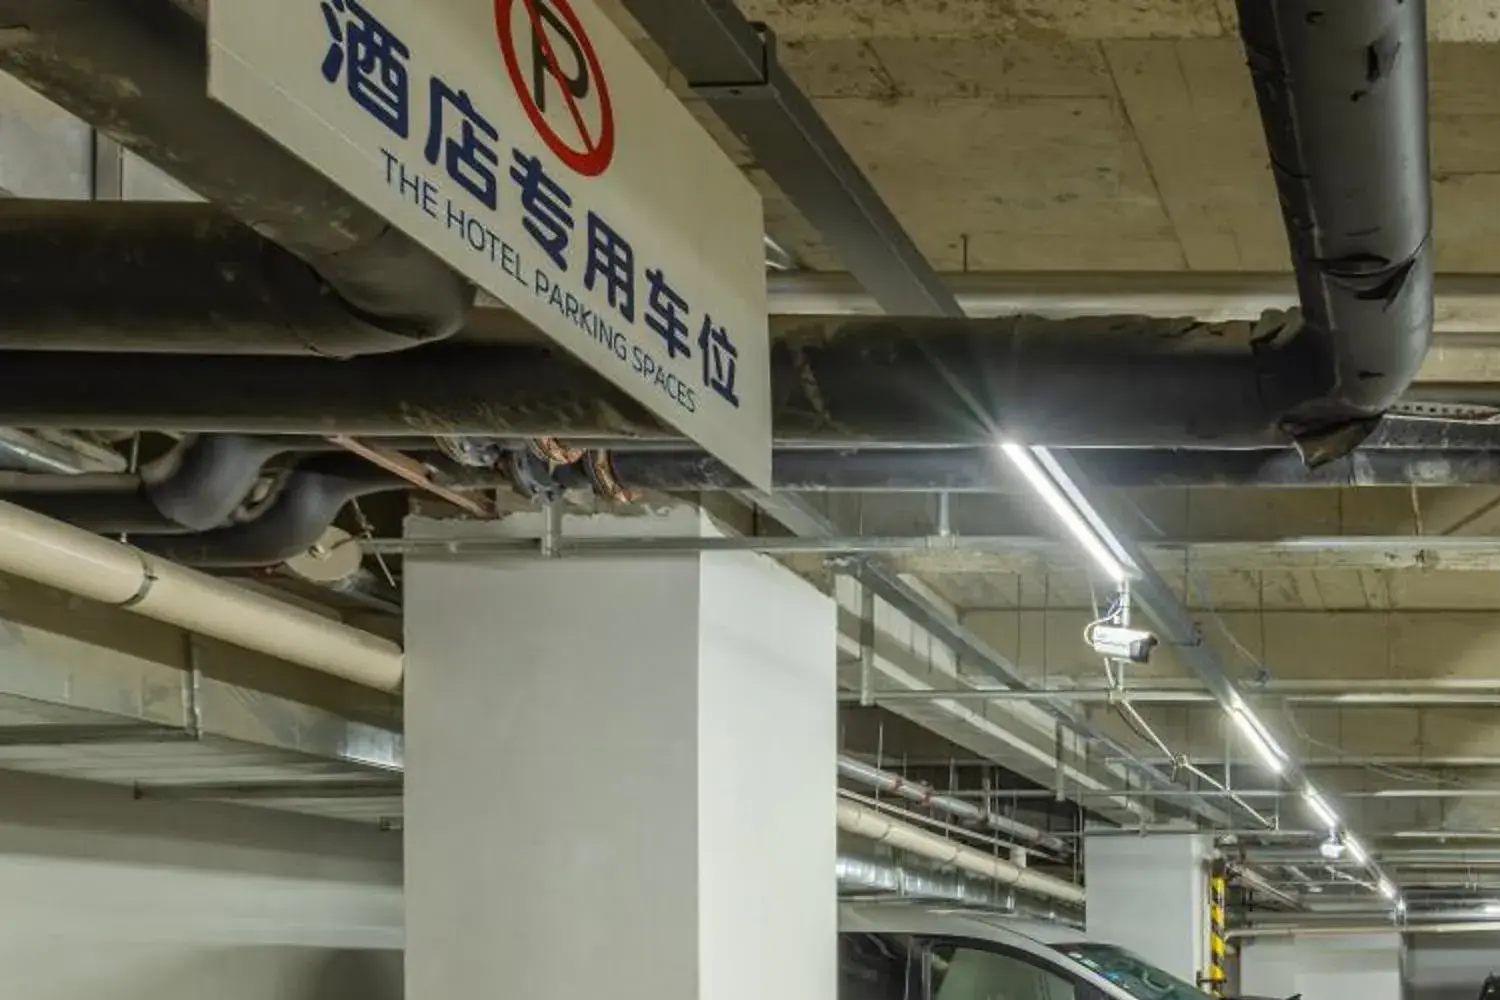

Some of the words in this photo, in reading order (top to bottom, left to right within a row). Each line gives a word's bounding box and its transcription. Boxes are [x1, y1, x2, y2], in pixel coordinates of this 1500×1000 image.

[319, 0, 738, 408] 酒店专用车位
[380, 147, 438, 220] THE
[446, 199, 528, 287] HOTEL
[535, 268, 627, 362] PARKING
[633, 345, 696, 414] SPACES
